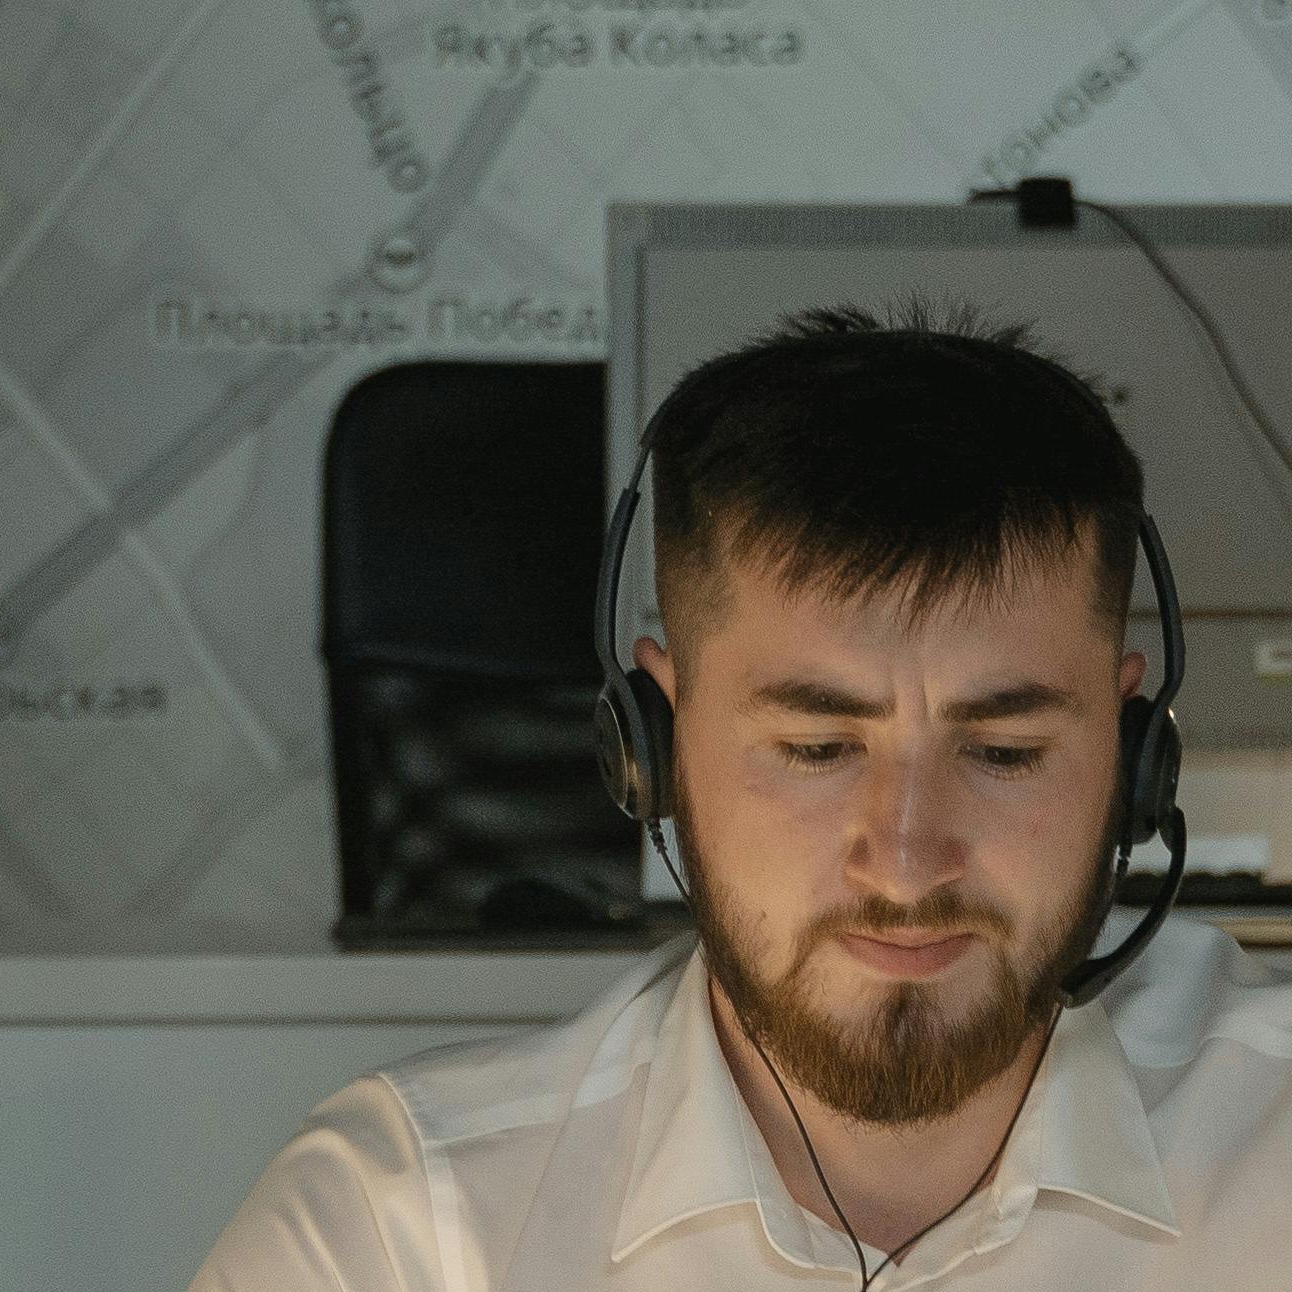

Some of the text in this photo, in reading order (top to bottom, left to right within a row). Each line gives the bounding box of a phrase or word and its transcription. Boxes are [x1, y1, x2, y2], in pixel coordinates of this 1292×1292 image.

[432, 18, 805, 80] Якуба Коласа
[154, 298, 602, 346] Площадь Побед
